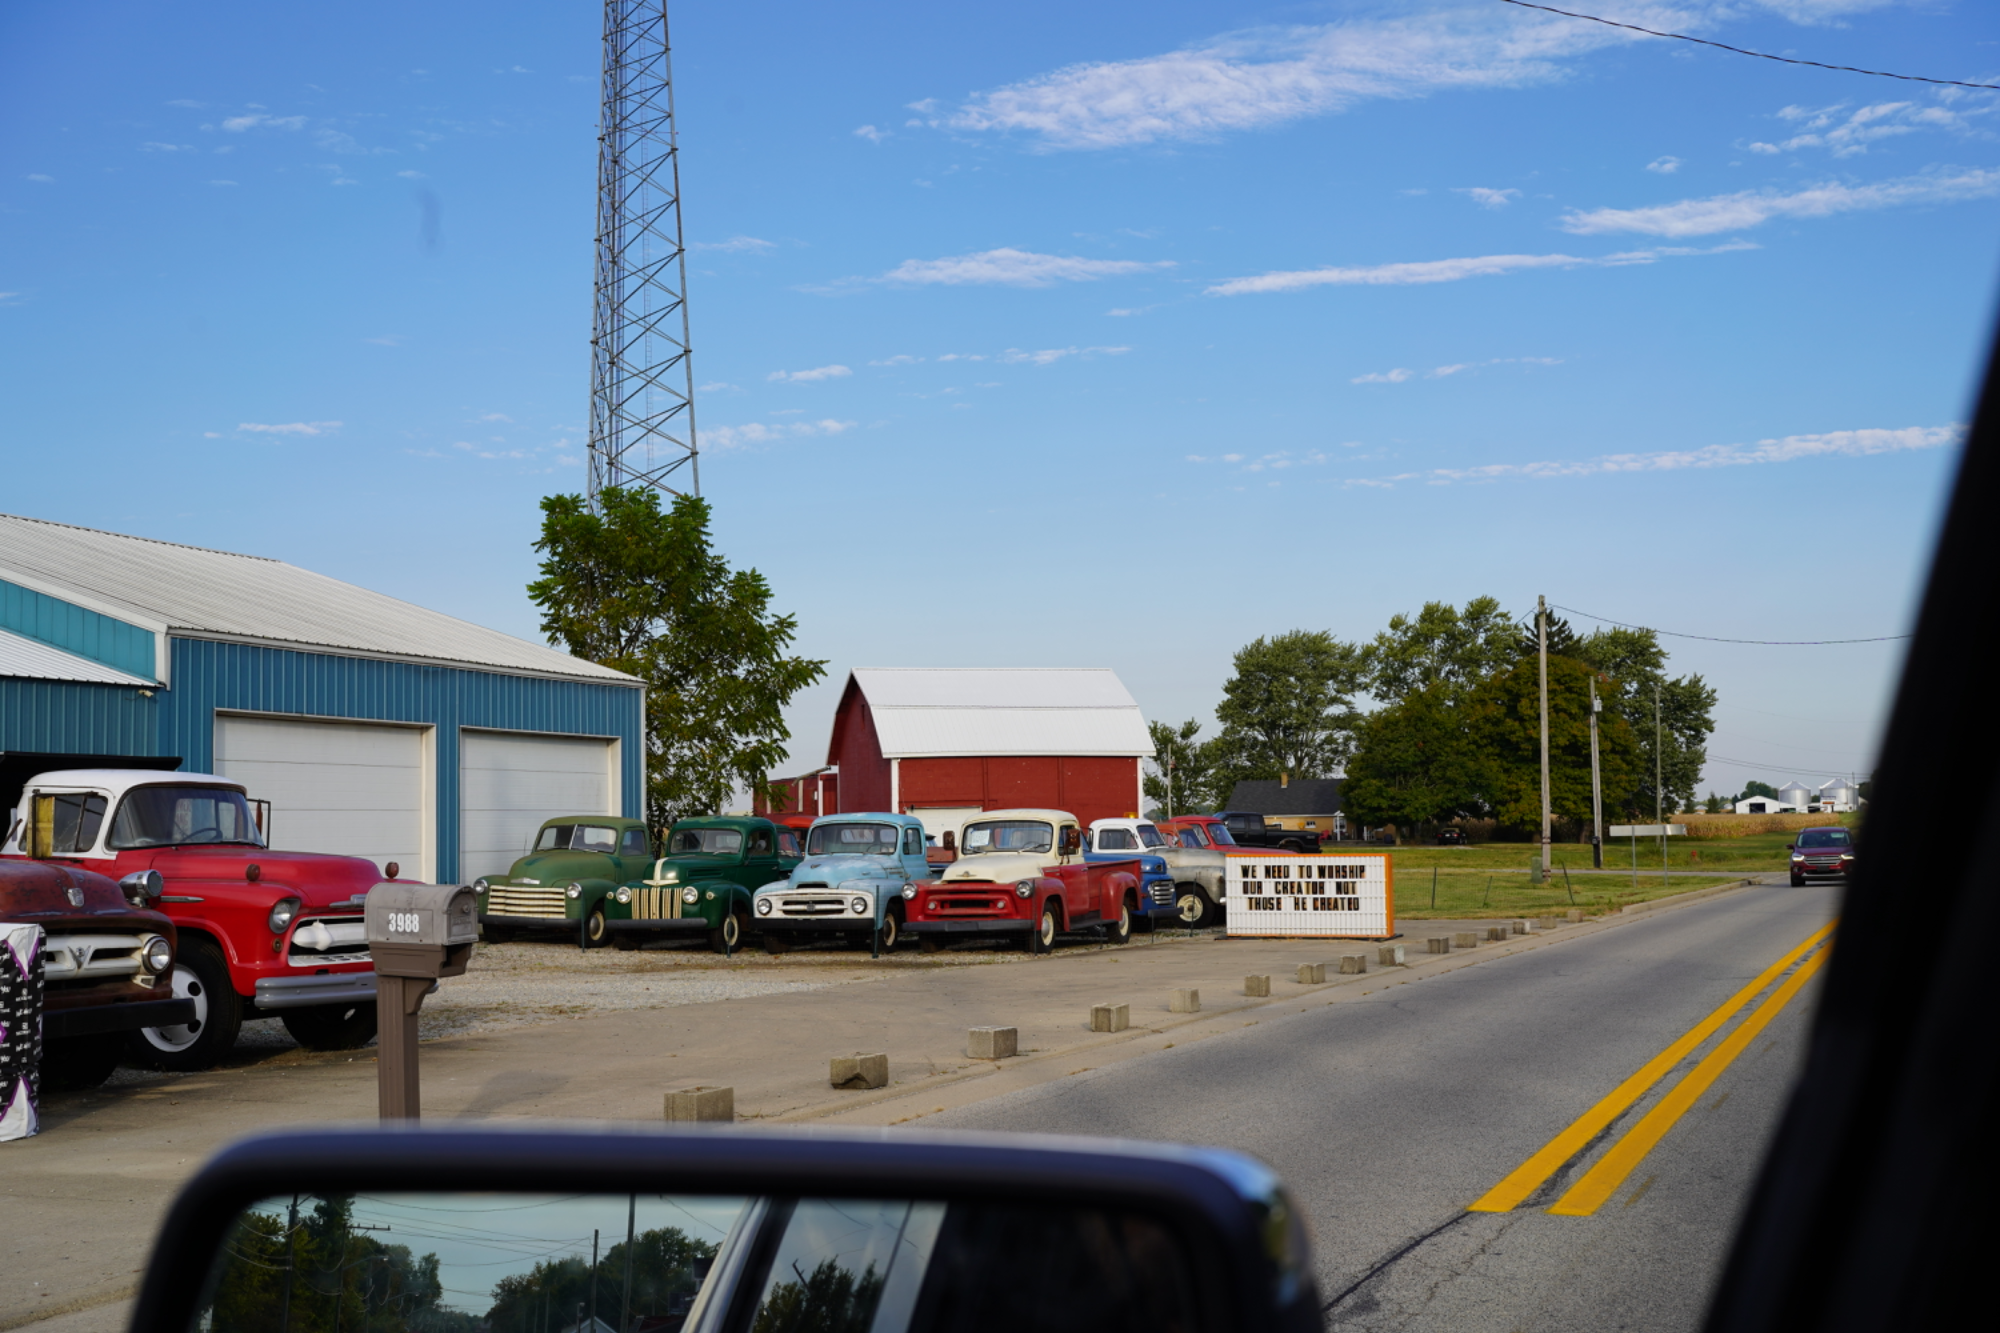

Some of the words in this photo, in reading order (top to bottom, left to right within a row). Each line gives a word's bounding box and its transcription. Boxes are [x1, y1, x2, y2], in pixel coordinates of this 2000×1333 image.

[1241, 865, 1257, 879] WE
[1264, 865, 1290, 879] NEED
[1298, 865, 1312, 879] TO
[1317, 865, 1365, 879] WORSHIP
[1242, 881, 1263, 895] OUR
[1275, 881, 1325, 895] CREATOR
[1335, 881, 1357, 895] NOT
[1248, 897, 1282, 911] THOSE
[1294, 897, 1307, 911] HE
[1313, 897, 1360, 911] CREATED
[388, 912, 420, 933] 3988
